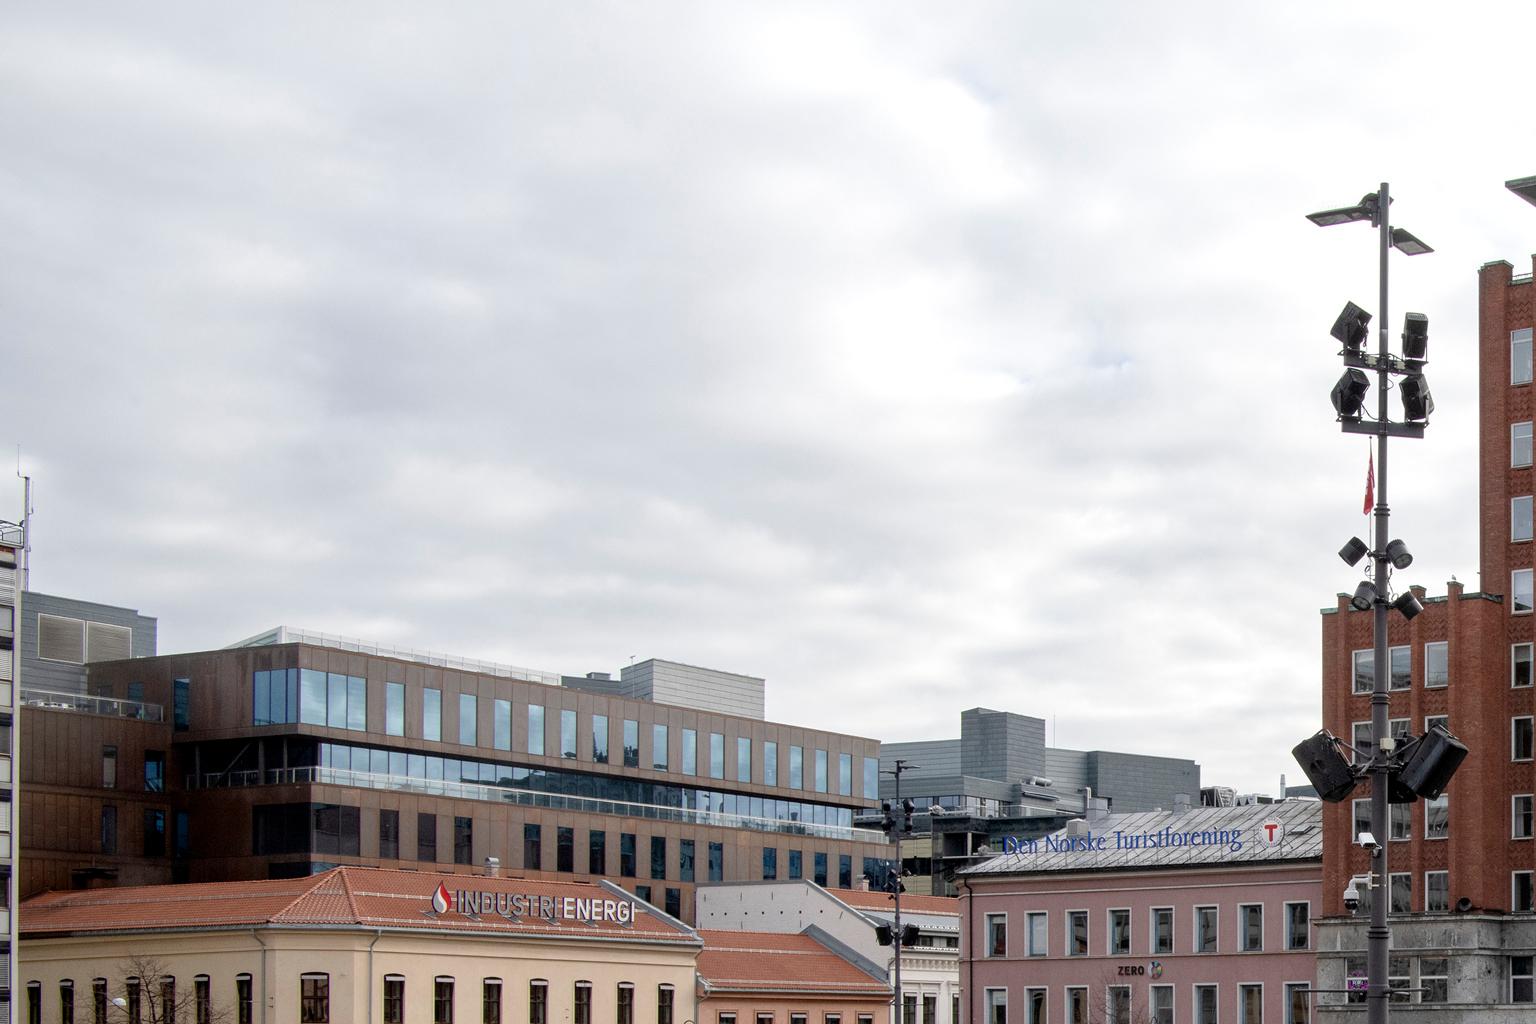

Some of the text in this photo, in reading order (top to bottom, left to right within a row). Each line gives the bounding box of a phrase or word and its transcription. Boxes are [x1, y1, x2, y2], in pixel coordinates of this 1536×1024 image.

[1002, 825, 1243, 855] Den Norske Turistforening
[1118, 966, 1145, 976] ZERO
